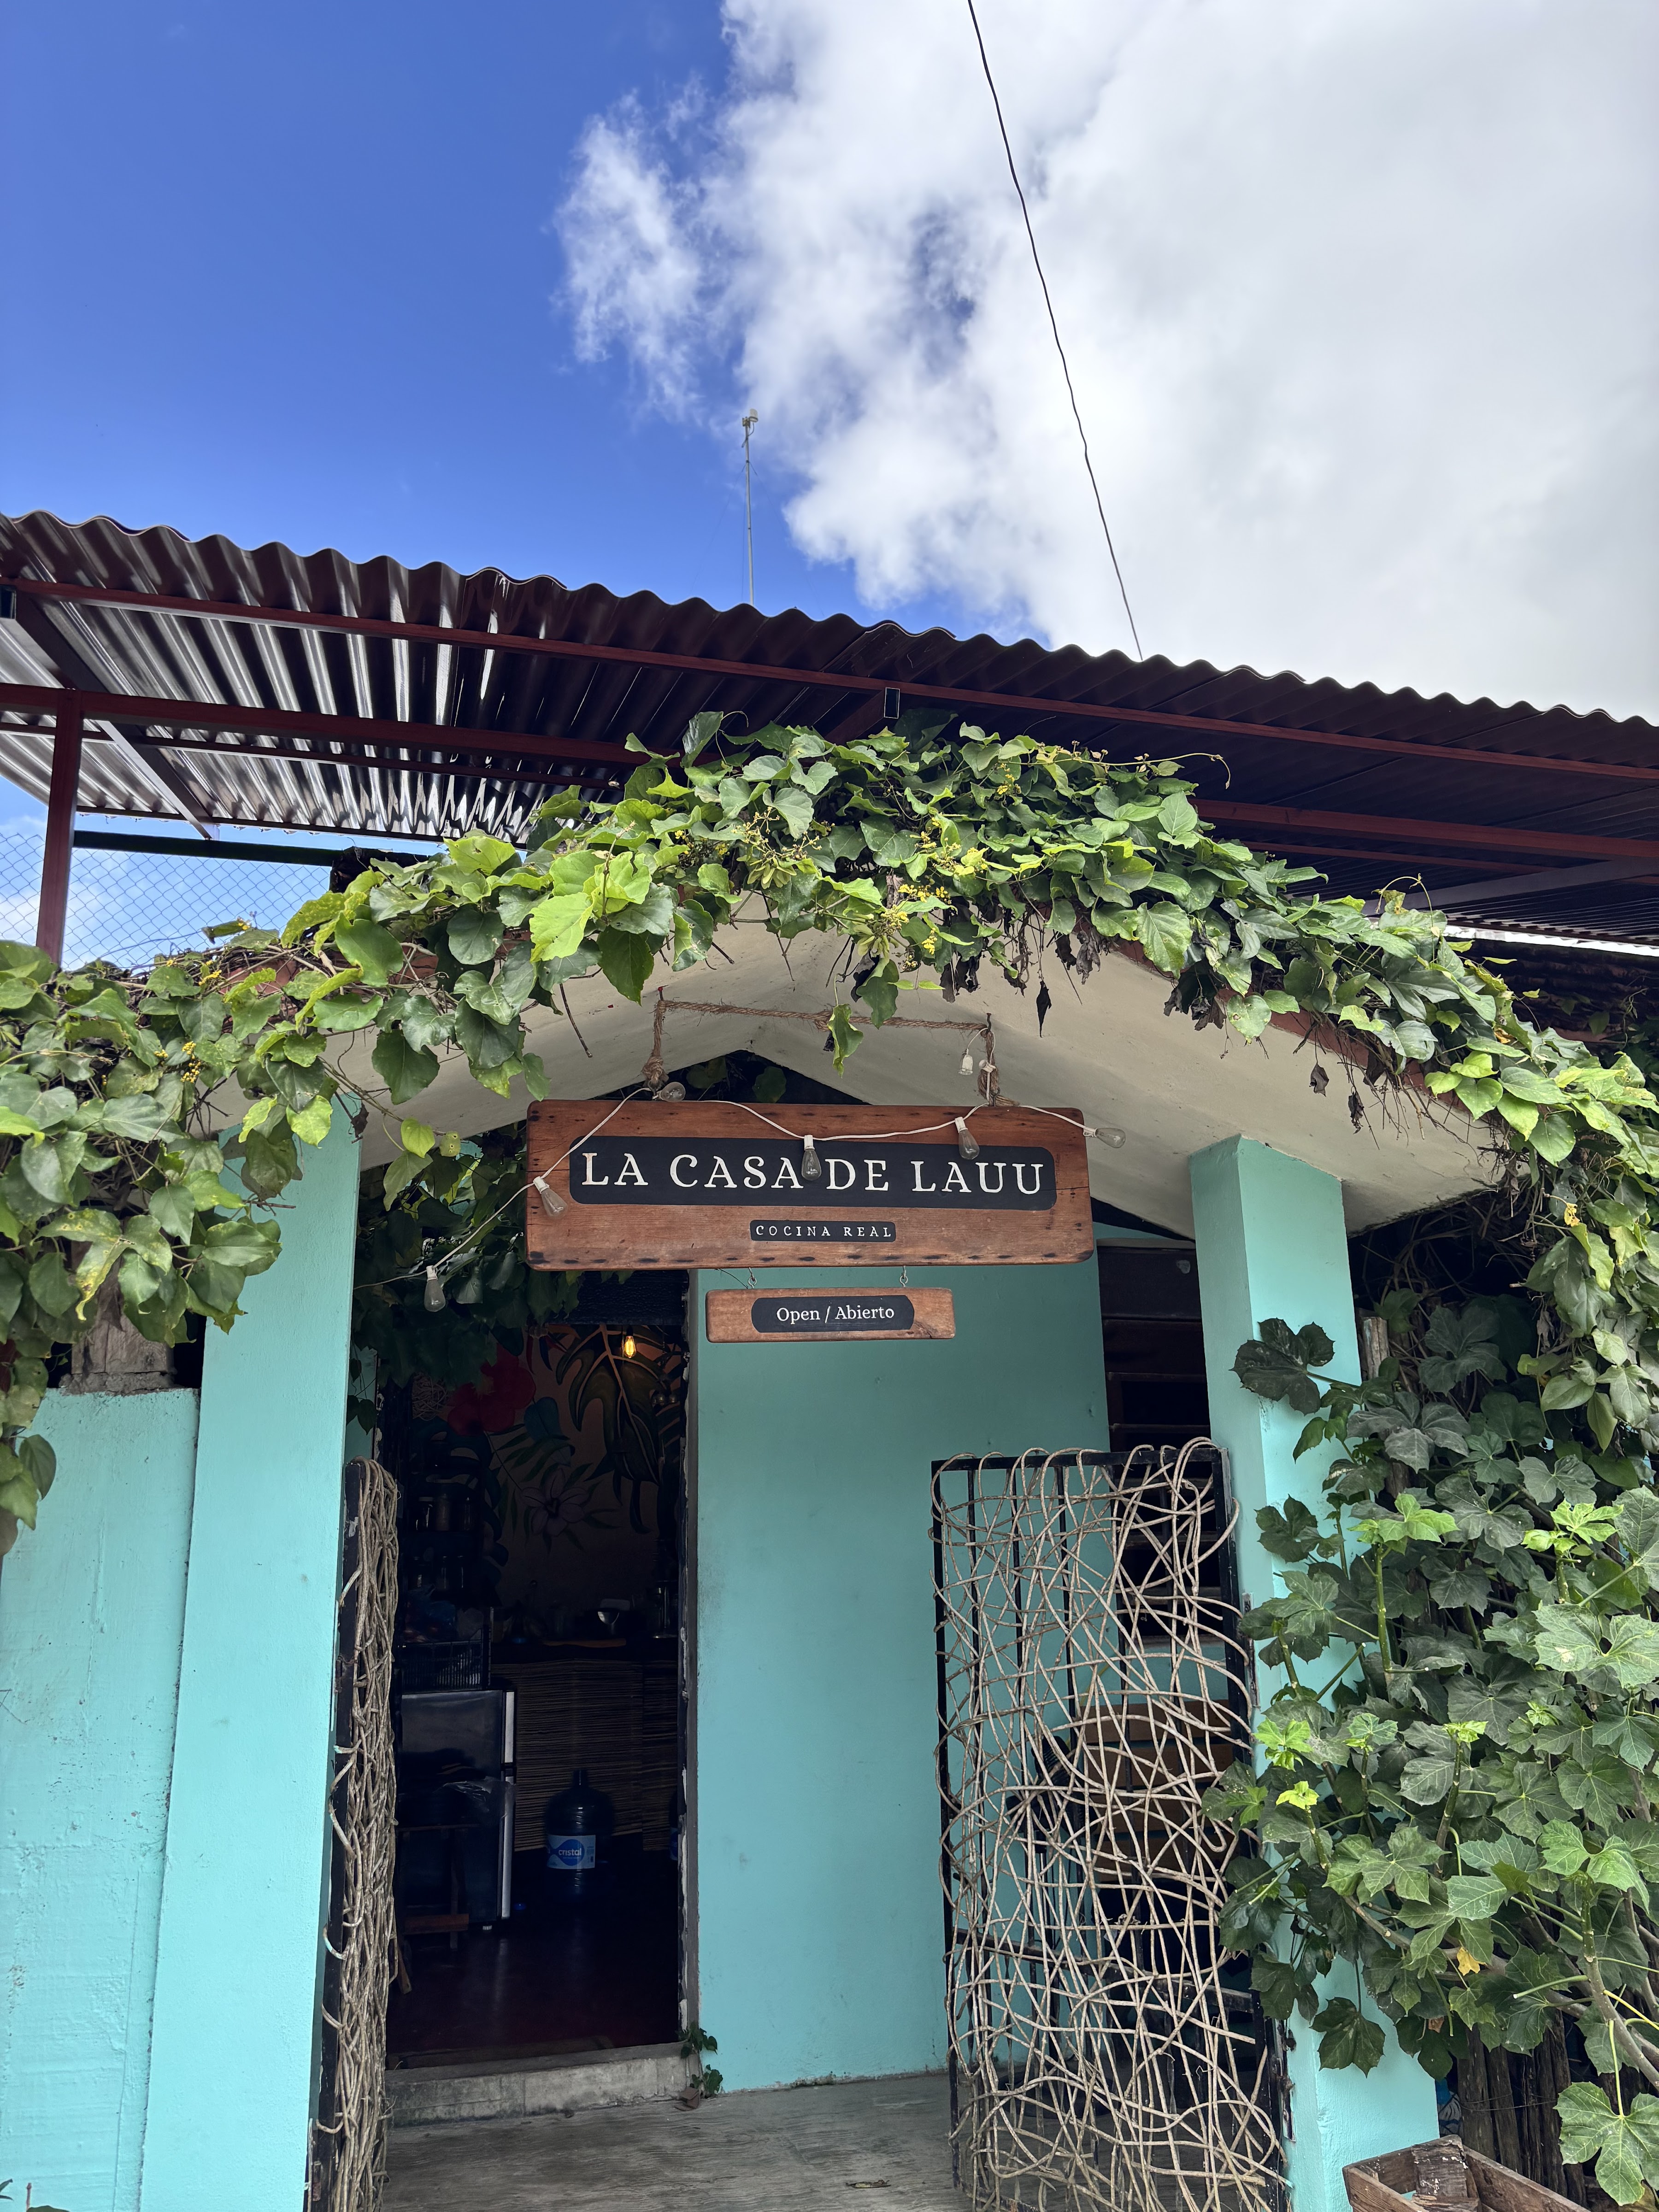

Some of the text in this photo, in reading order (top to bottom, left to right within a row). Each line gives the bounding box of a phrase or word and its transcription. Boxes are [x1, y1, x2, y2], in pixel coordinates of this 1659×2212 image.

[582, 1153, 1044, 1194] LA CASA DE LAUU
[756, 1225, 891, 1237] COCINA REAL
[777, 1305, 894, 1325] Open / Abierto
[558, 1847, 582, 1856] cristal
